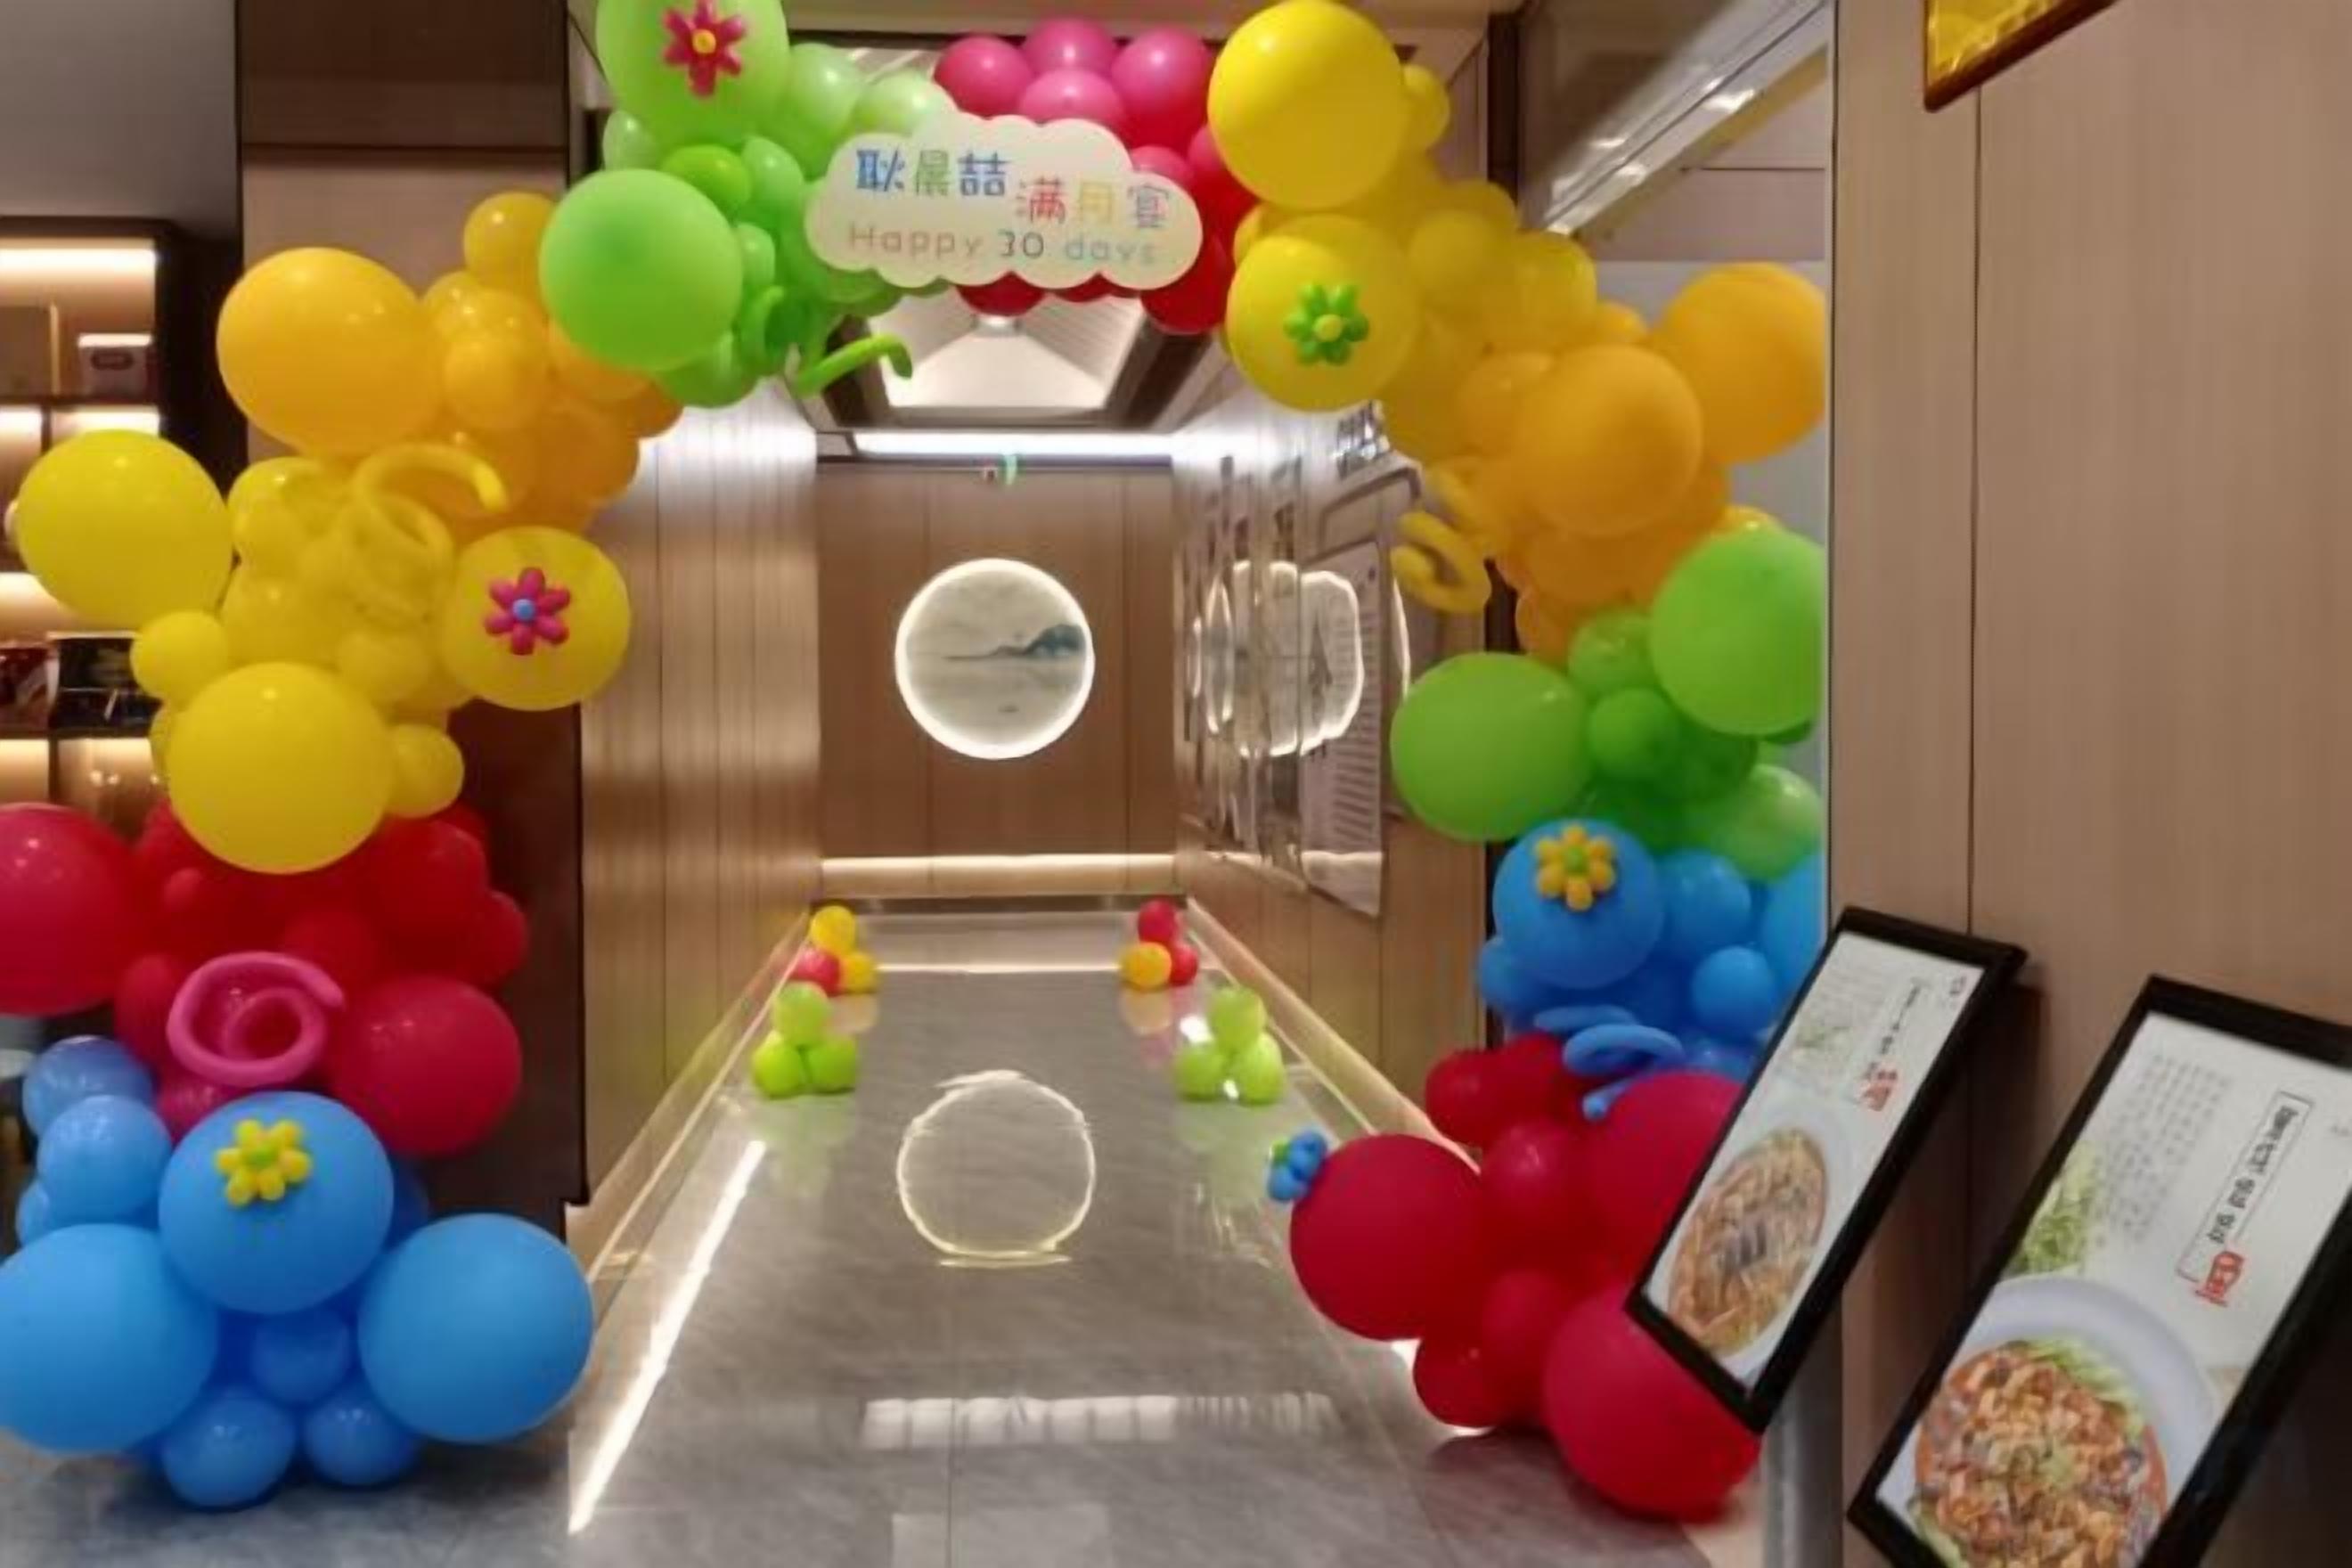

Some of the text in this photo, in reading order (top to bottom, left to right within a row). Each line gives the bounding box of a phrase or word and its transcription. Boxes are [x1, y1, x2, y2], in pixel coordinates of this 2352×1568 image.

[849, 221, 1158, 264] Happy 30 days
